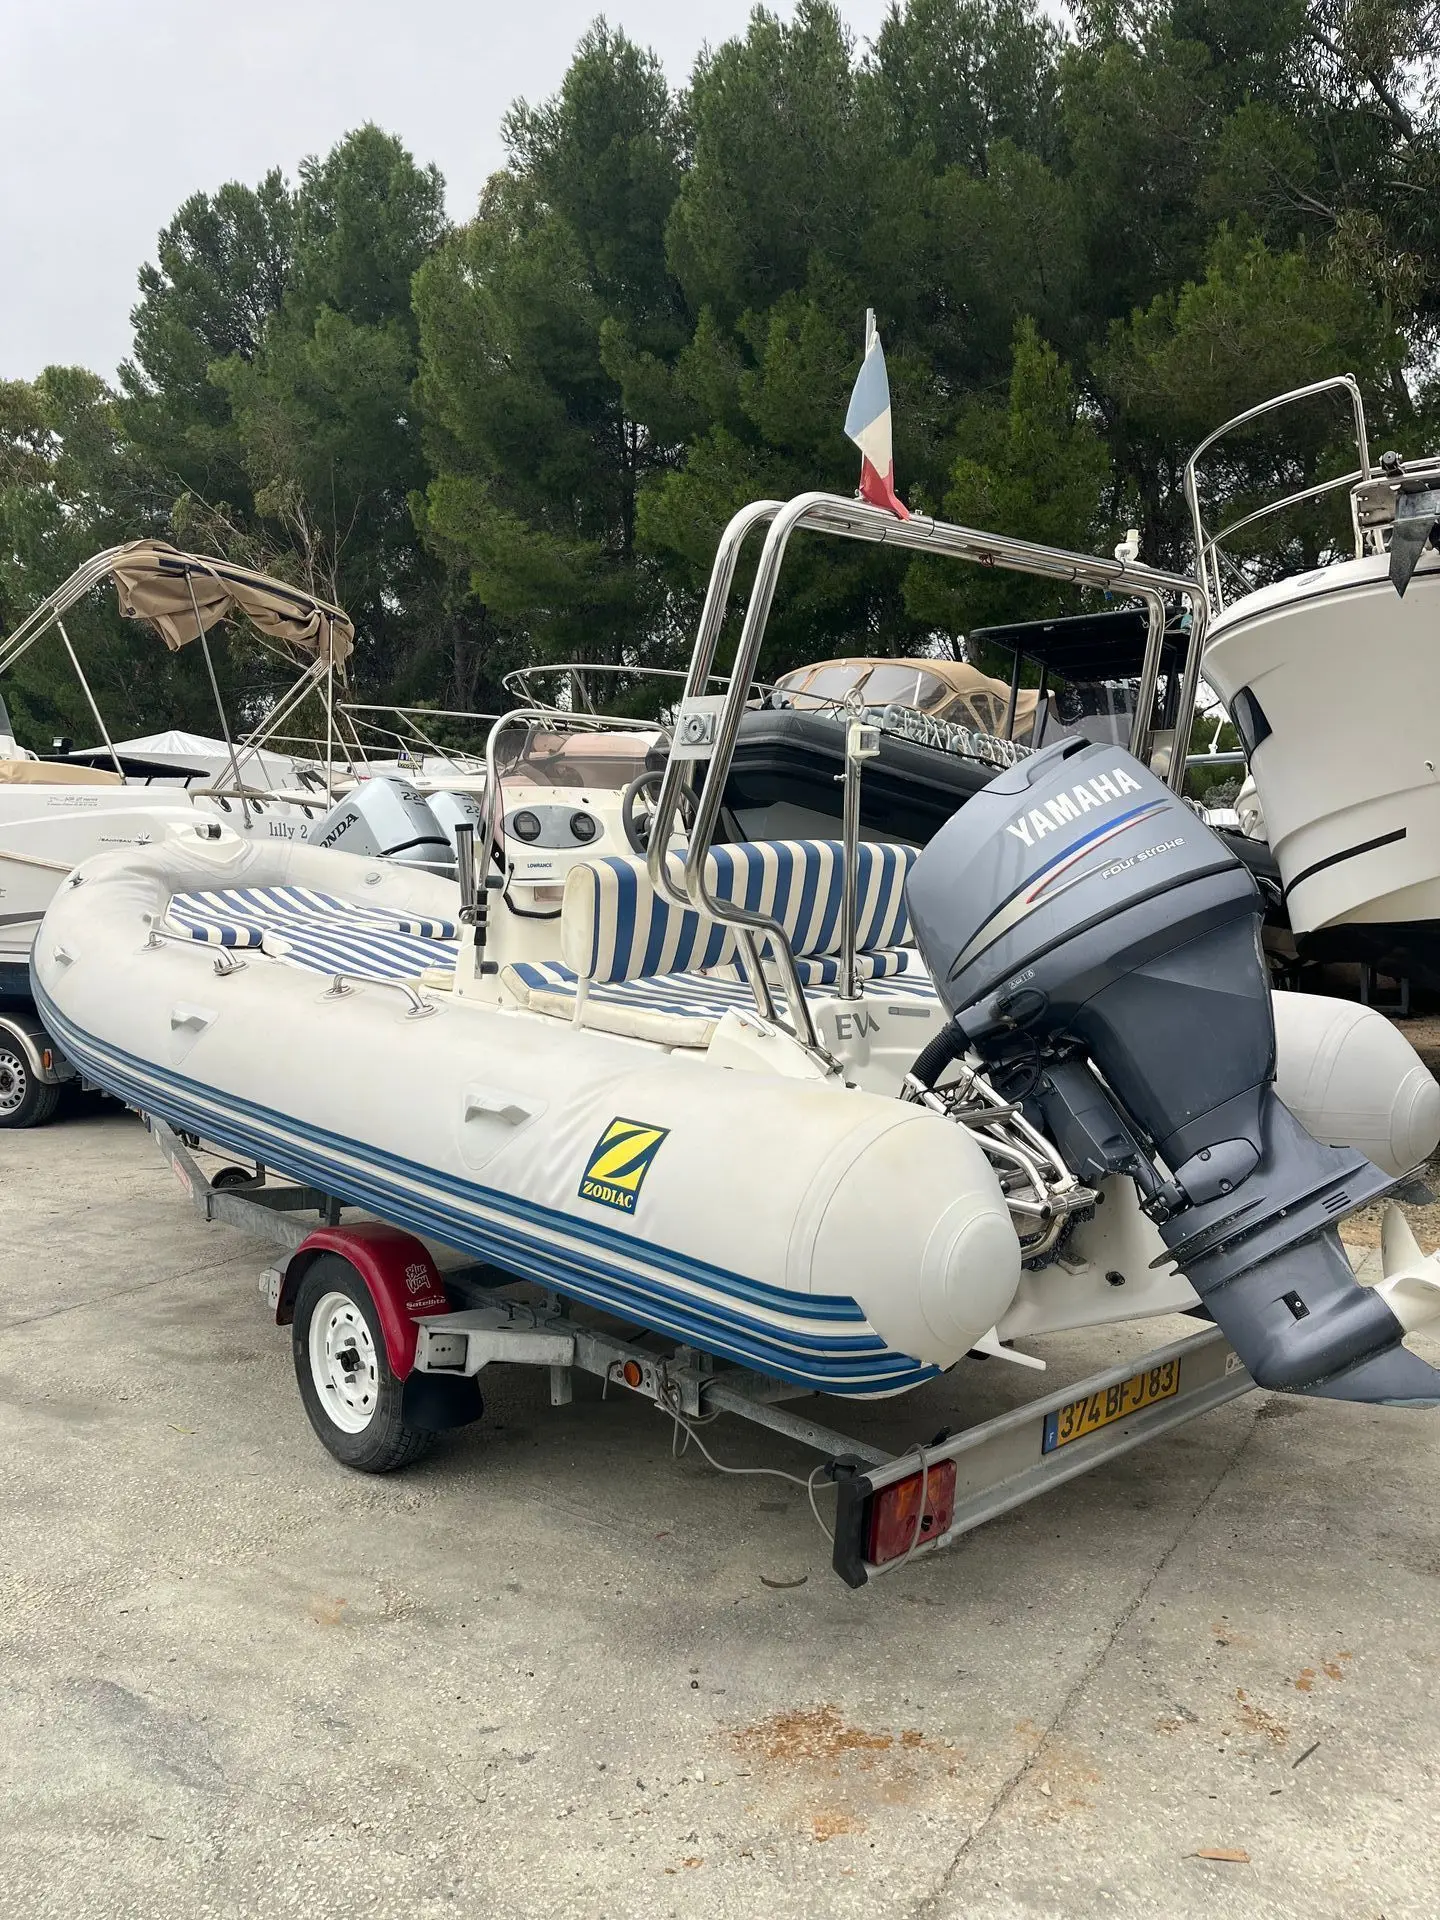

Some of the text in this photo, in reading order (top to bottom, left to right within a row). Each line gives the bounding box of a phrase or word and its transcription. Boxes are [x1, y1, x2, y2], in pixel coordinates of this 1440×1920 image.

[1006, 767, 1143, 847] YAMAHA
[300, 824, 308, 839] 2
[582, 1180, 634, 1208] ZODIAC
[405, 1263, 427, 1279] Blue
[405, 1274, 431, 1294] Way
[1059, 1360, 1175, 1439] 374 BFJ 83
